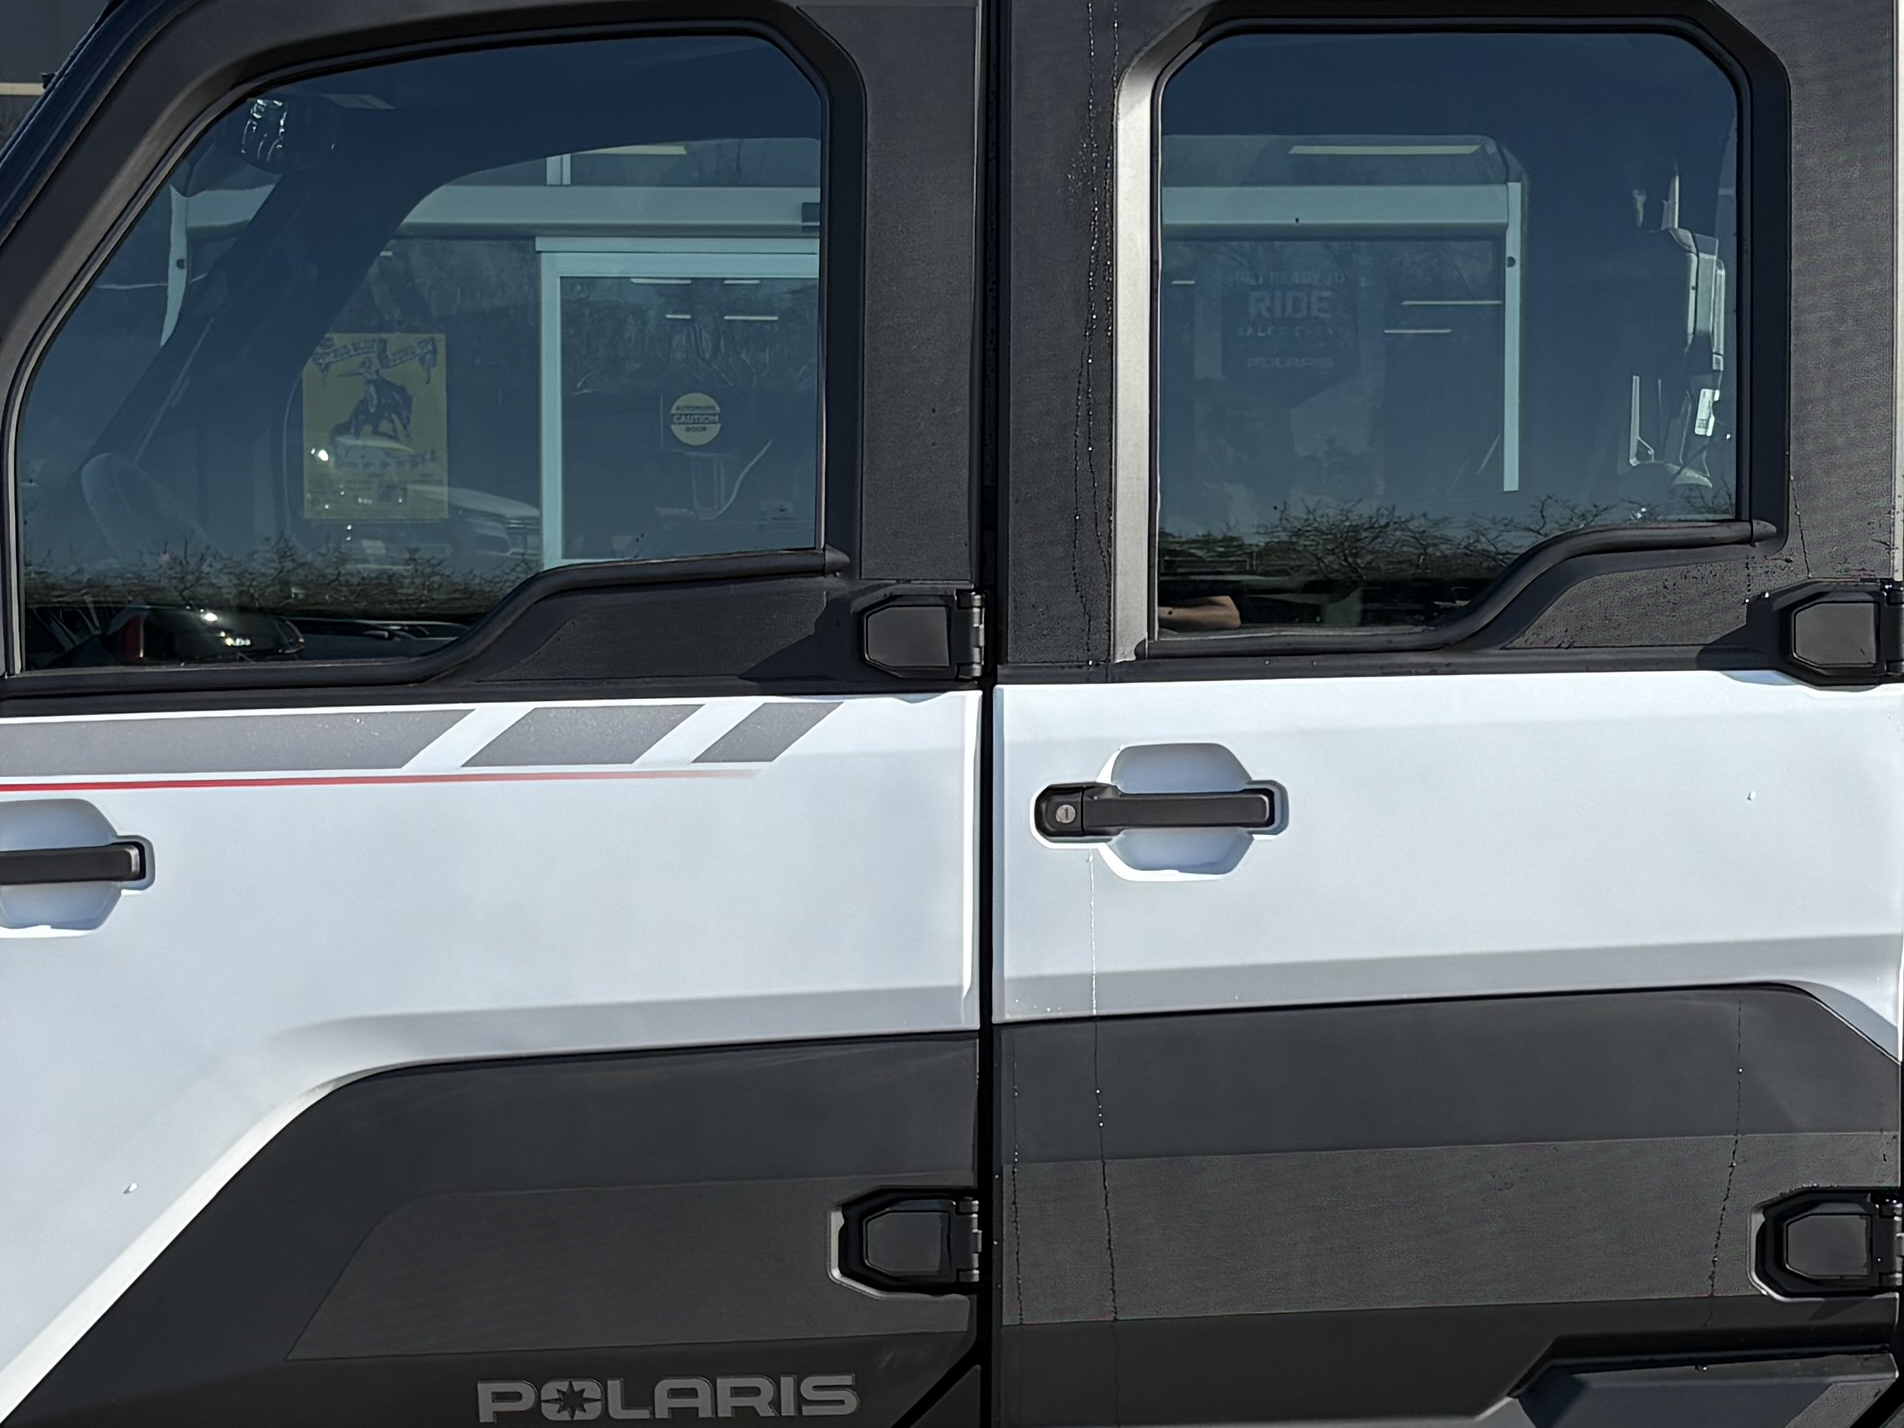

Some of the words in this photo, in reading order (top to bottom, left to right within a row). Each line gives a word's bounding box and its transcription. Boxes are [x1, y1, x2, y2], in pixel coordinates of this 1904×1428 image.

[1248, 290, 1332, 319] RIDE
[672, 414, 720, 424] CAUTION
[477, 1372, 860, 1423] POLARIS
